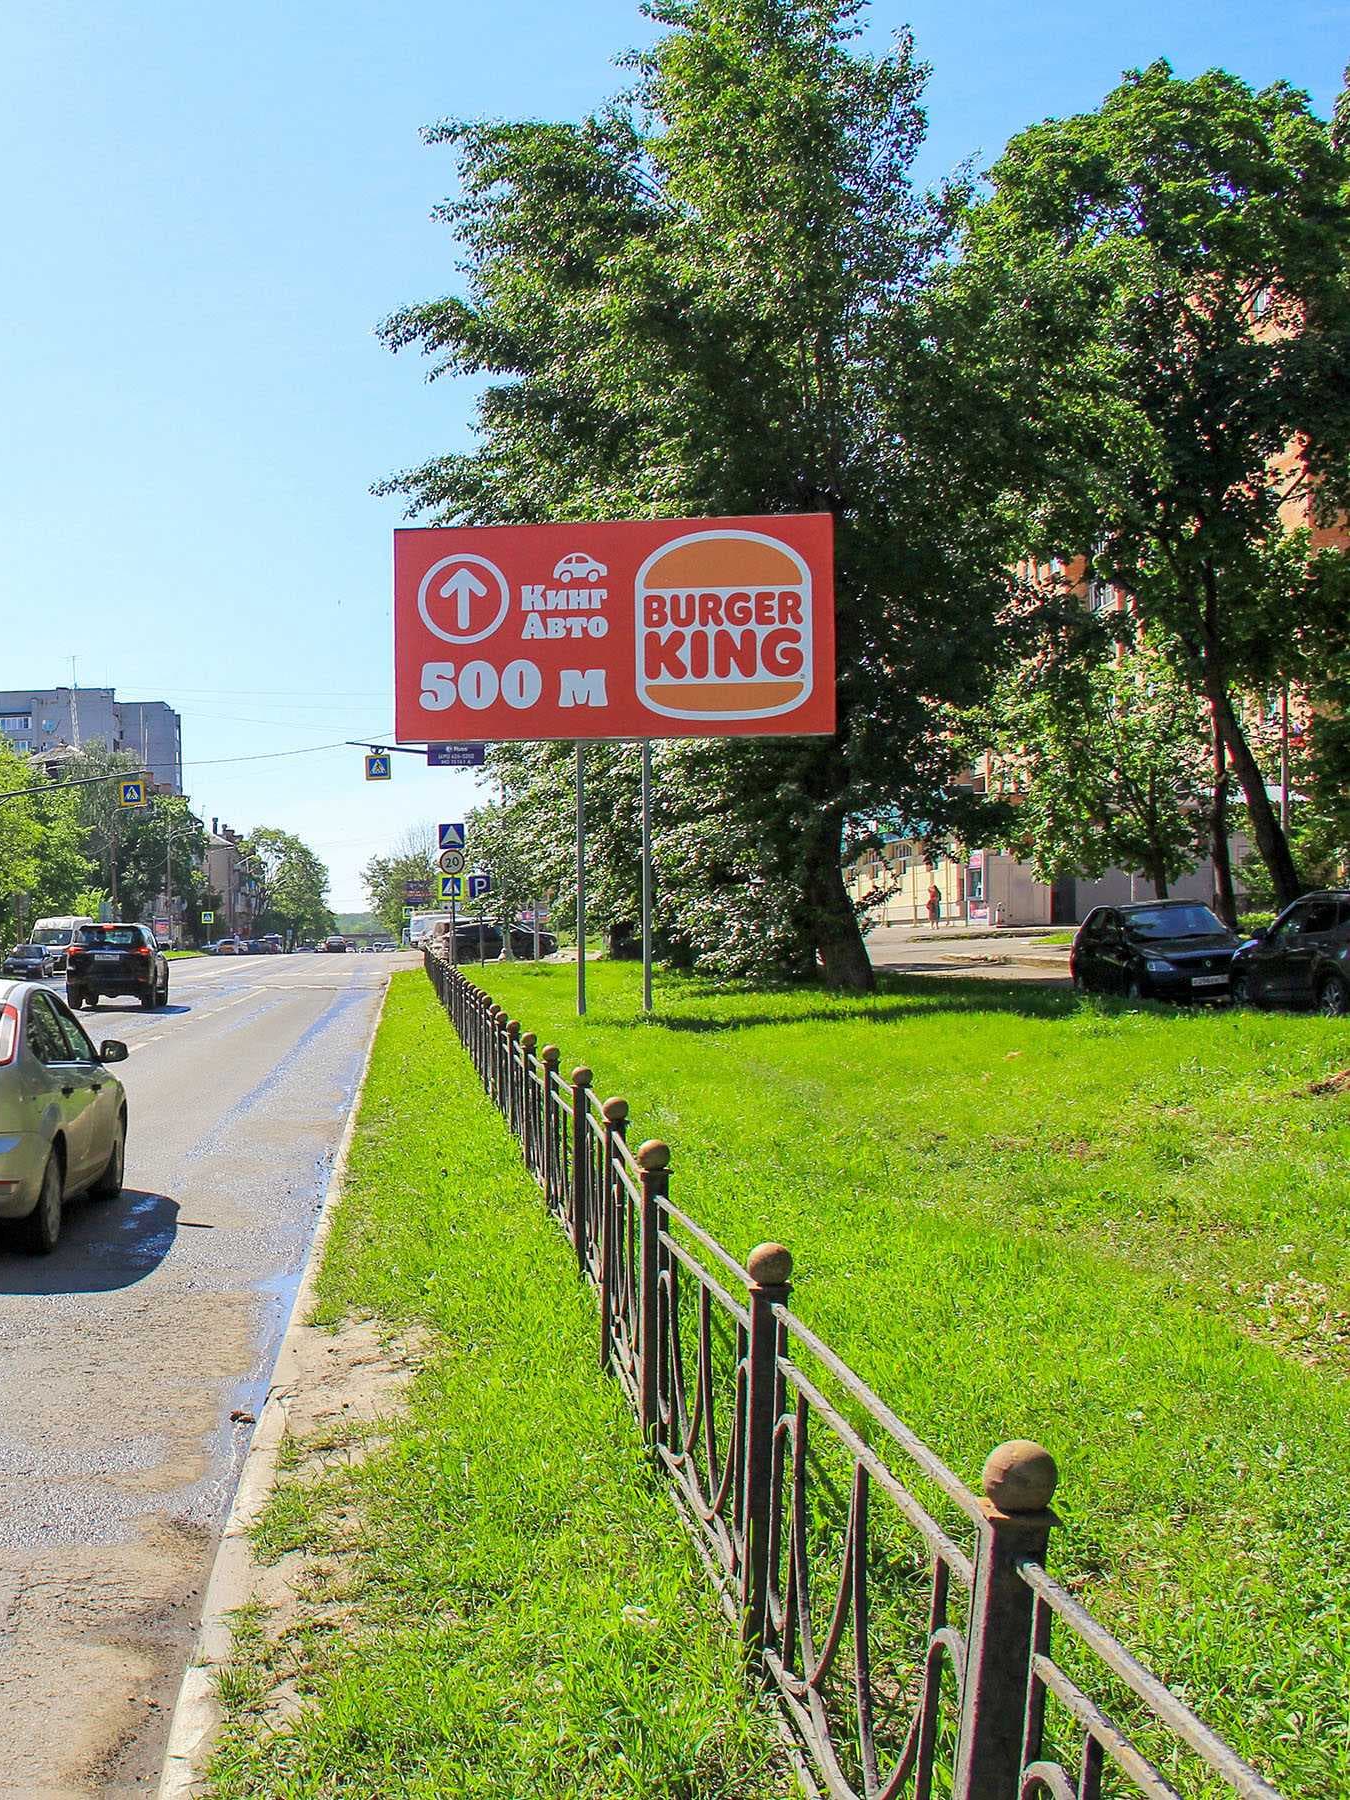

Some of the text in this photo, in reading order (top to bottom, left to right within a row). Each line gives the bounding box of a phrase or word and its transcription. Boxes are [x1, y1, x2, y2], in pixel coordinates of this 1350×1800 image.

[521, 584, 608, 611] Кинг
[643, 591, 804, 628] BURGER
[521, 613, 609, 640] Авто
[643, 627, 805, 681] KING
[418, 659, 543, 711] 500
[446, 856, 460, 868] 20
